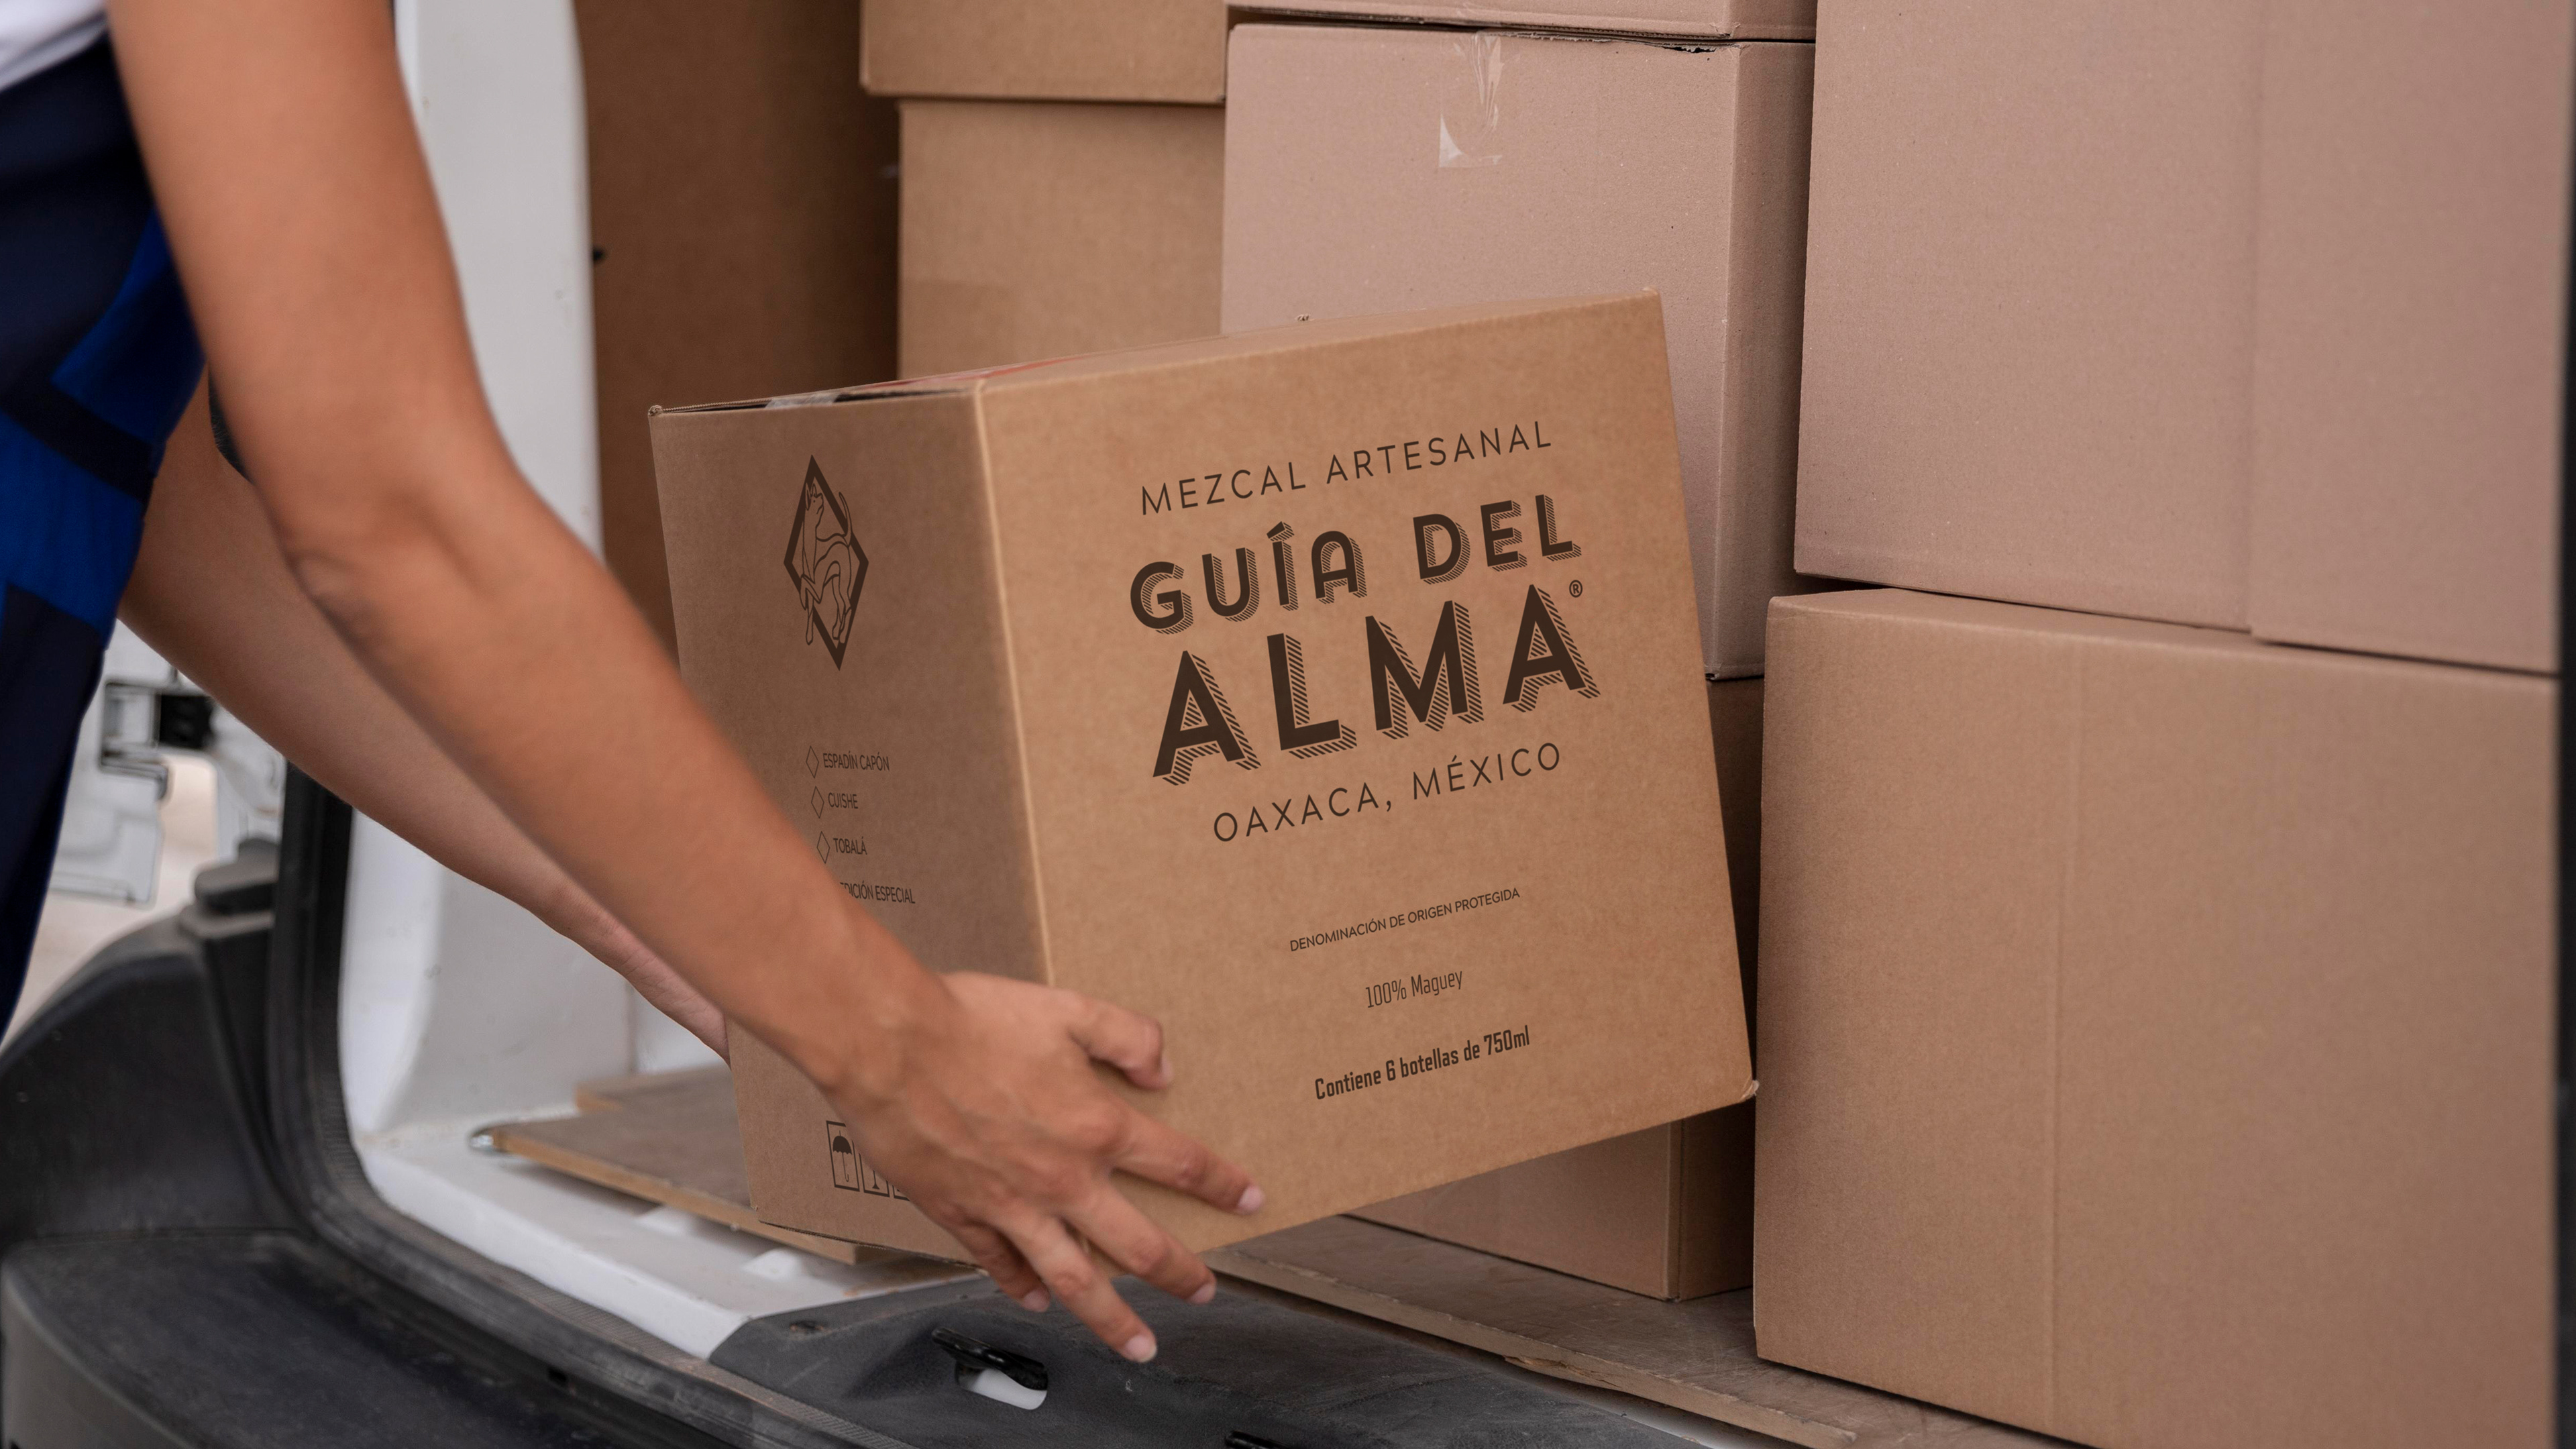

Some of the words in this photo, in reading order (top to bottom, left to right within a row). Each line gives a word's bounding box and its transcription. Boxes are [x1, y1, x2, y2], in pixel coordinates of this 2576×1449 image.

[1142, 462, 1306, 516] MEZCAL
[1326, 421, 1552, 484] ARTESANAL
[1130, 521, 1368, 635] GUÍA
[1413, 494, 1582, 585] DEL
[822, 751, 858, 769] ESPADÍN
[859, 751, 890, 771] CAPÓN
[828, 792, 859, 809] CUISHE
[1214, 782, 1392, 842] OAXACA,
[1413, 742, 1560, 800] MÉXICO
[833, 837, 867, 855] TOBALÁ
[840, 880, 873, 900] DICIÓN
[875, 885, 916, 904] ESPECIAL
[1289, 918, 1387, 952] DENOMINACIÓN
[1389, 914, 1405, 928] DE
[1407, 902, 1452, 924] ORIGEN
[1454, 888, 1521, 912] PROTEGIDA
[1365, 979, 1407, 1008] 100%
[1411, 971, 1462, 997] Maguey
[1315, 1070, 1381, 1100] Contiene
[1385, 1059, 1397, 1081] 6
[1399, 1047, 1459, 1078] botellas
[1463, 1039, 1481, 1061] de
[1483, 1024, 1530, 1056] 750ml
